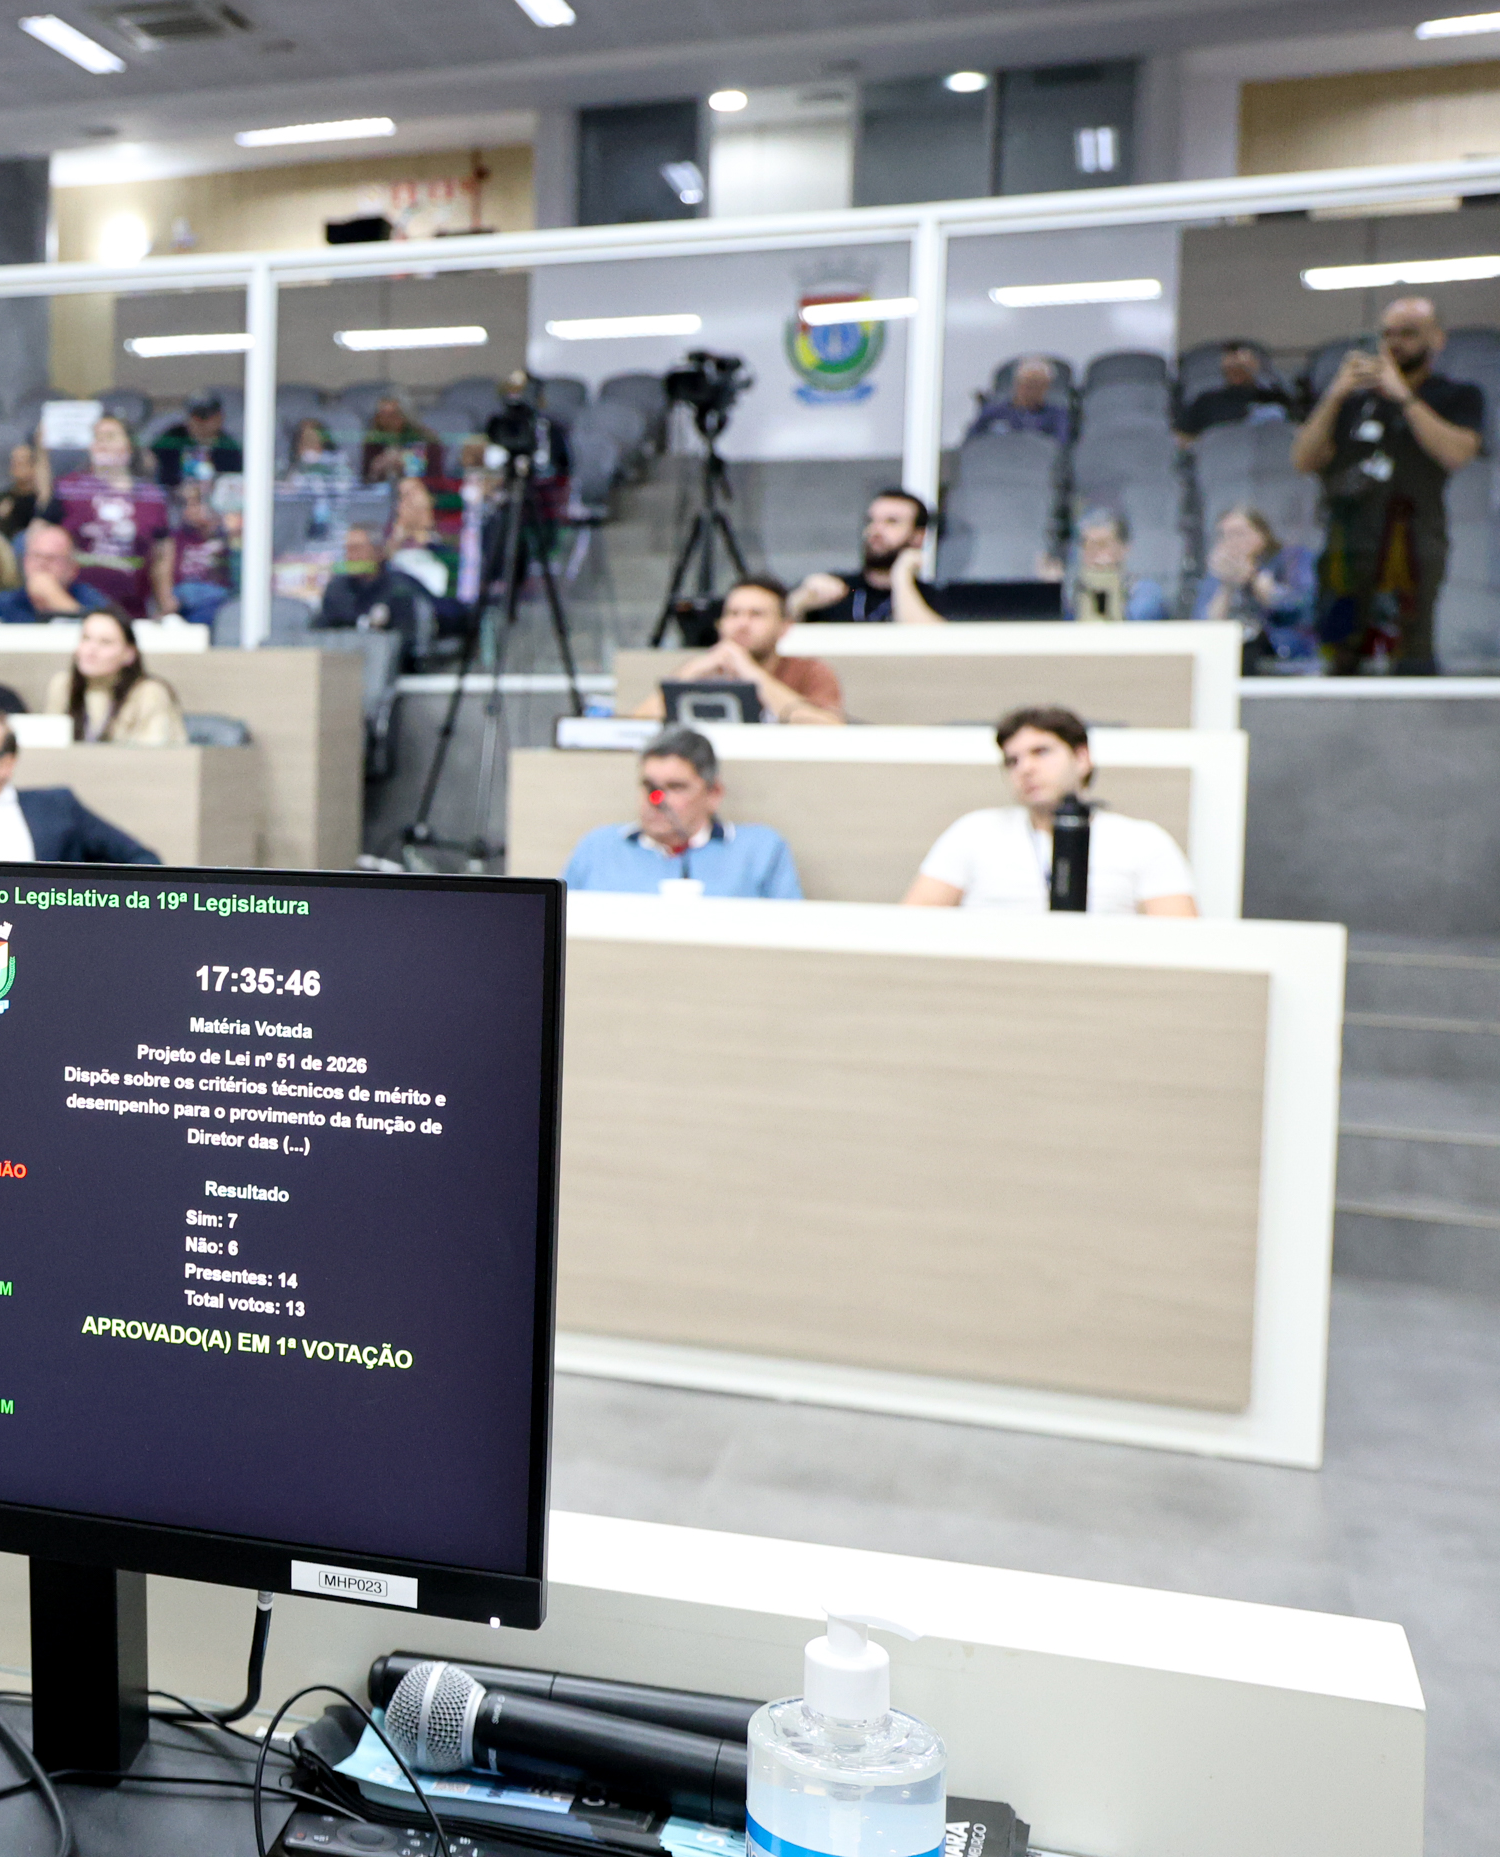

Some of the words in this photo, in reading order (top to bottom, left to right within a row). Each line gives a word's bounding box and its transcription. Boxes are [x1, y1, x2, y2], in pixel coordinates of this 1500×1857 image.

[14, 886, 120, 910] Legislativa
[125, 890, 150, 909] da
[155, 891, 188, 910] 19ª
[193, 893, 310, 917] Legislatura
[195, 965, 321, 996] 17:35:46
[189, 1017, 251, 1037] Matéria
[254, 1020, 313, 1040] Votada
[137, 1044, 196, 1065] Projeto
[199, 1047, 221, 1065] de
[224, 1049, 251, 1067] Lei
[254, 1051, 273, 1068] nº
[276, 1052, 296, 1070] 51
[300, 1054, 323, 1071] de
[326, 1056, 368, 1074] 2026
[64, 1066, 120, 1086] Dispõe
[123, 1070, 171, 1088] sobre
[173, 1074, 195, 1090] os
[198, 1076, 268, 1095] critérios
[271, 1081, 344, 1100] técnicos
[347, 1086, 370, 1102] de
[374, 1088, 431, 1107] mérito
[435, 1093, 447, 1107] e
[66, 1093, 170, 1116] desempenho
[173, 1102, 210, 1120] para
[213, 1106, 225, 1120] o
[229, 1106, 326, 1127] provimento
[329, 1111, 351, 1128] da
[355, 1112, 416, 1134] função
[419, 1117, 443, 1135] de
[187, 1128, 245, 1148] Diretor
[247, 1134, 279, 1151] das
[282, 1135, 311, 1156] (...)
[204, 1180, 290, 1203] Resultado
[185, 1209, 223, 1228] Sim:
[227, 1212, 239, 1229] 7
[185, 1236, 224, 1255] Não:
[227, 1240, 239, 1257] 6
[184, 1262, 273, 1287] Presentes:
[277, 1271, 298, 1289] 14
[183, 1289, 224, 1309] Total
[227, 1296, 281, 1315] votos:
[285, 1300, 306, 1317] 13
[81, 1315, 232, 1355] APROVADO(A)
[237, 1332, 270, 1354] EM
[276, 1336, 297, 1356] 1ª
[302, 1338, 414, 1370] VOTAÇÃO
[324, 1574, 382, 1594] MHP023
